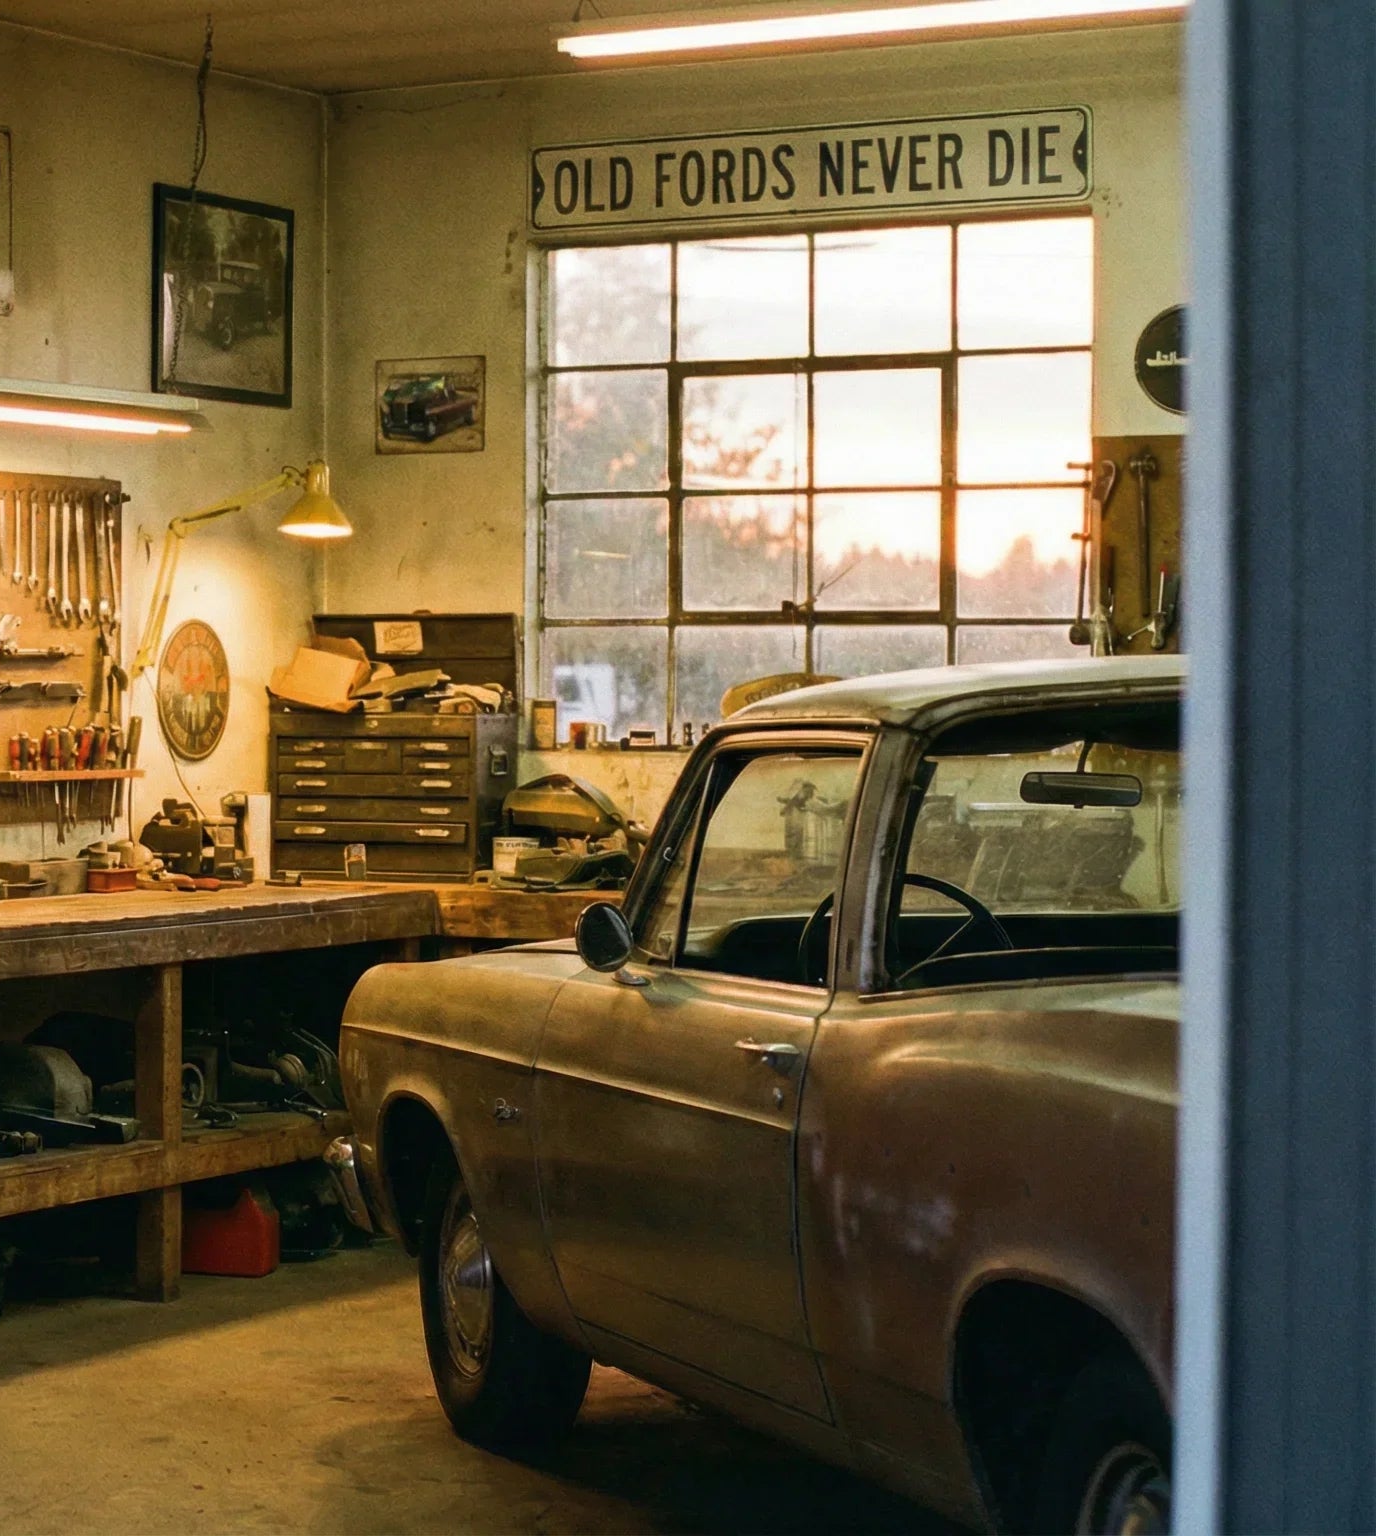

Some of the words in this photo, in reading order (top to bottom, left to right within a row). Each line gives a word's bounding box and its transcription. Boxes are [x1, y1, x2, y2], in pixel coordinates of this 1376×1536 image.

[553, 156, 634, 215] OLD
[654, 143, 796, 208] FORDS
[818, 133, 964, 197] NEVER
[988, 125, 1063, 187] DIE
